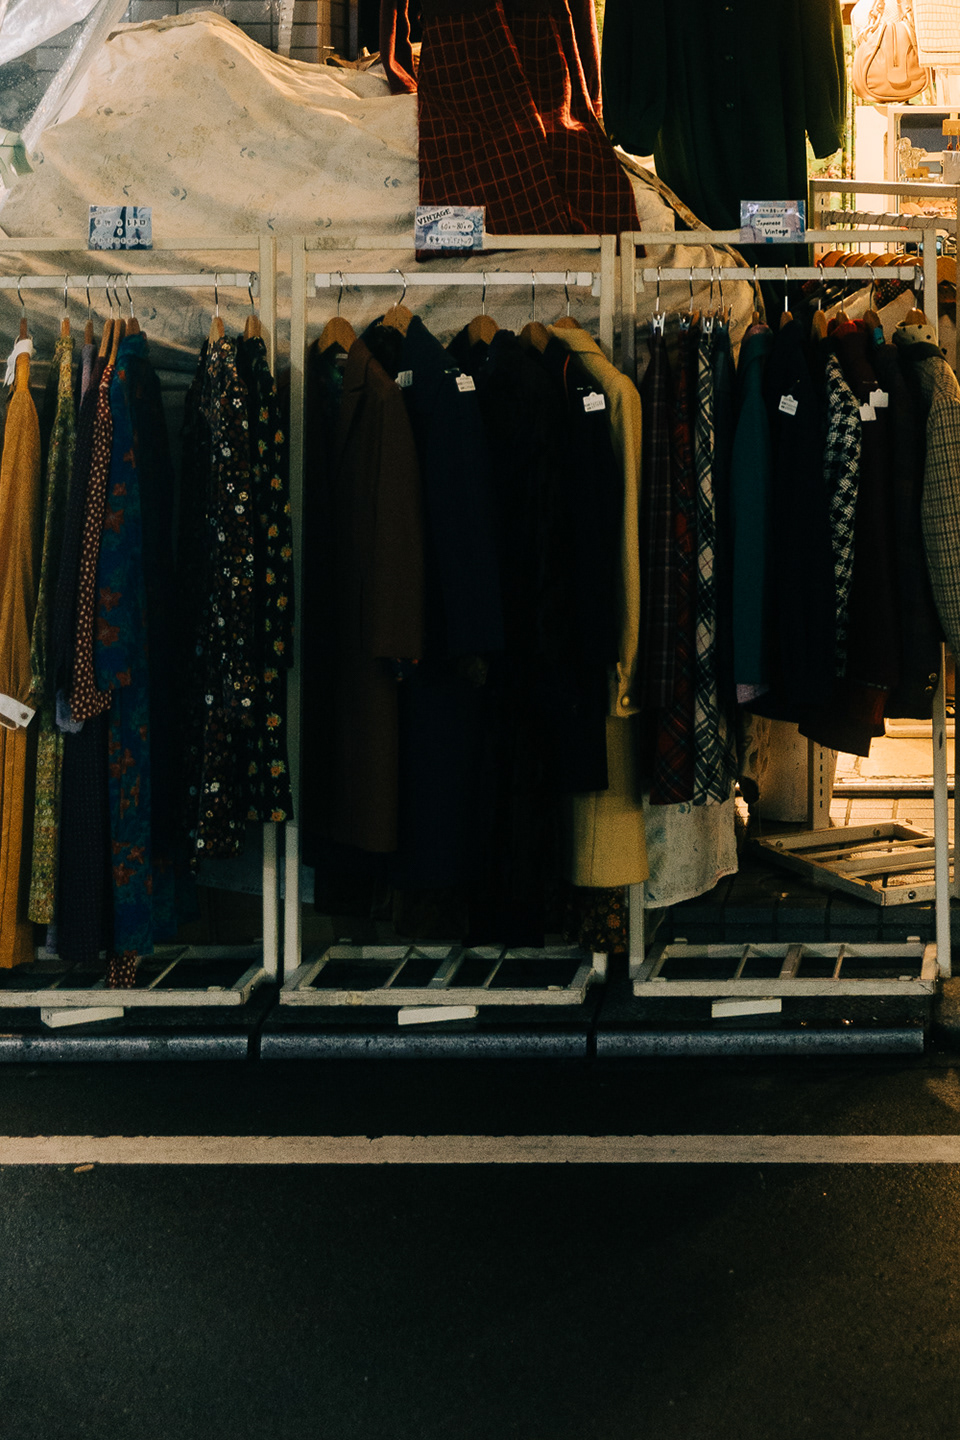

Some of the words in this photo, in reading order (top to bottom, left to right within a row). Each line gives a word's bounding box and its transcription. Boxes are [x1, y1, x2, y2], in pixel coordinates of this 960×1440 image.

[417, 208, 452, 225] VINTAGE
[756, 219, 781, 227] Japanese
[764, 228, 789, 237] Vintage
